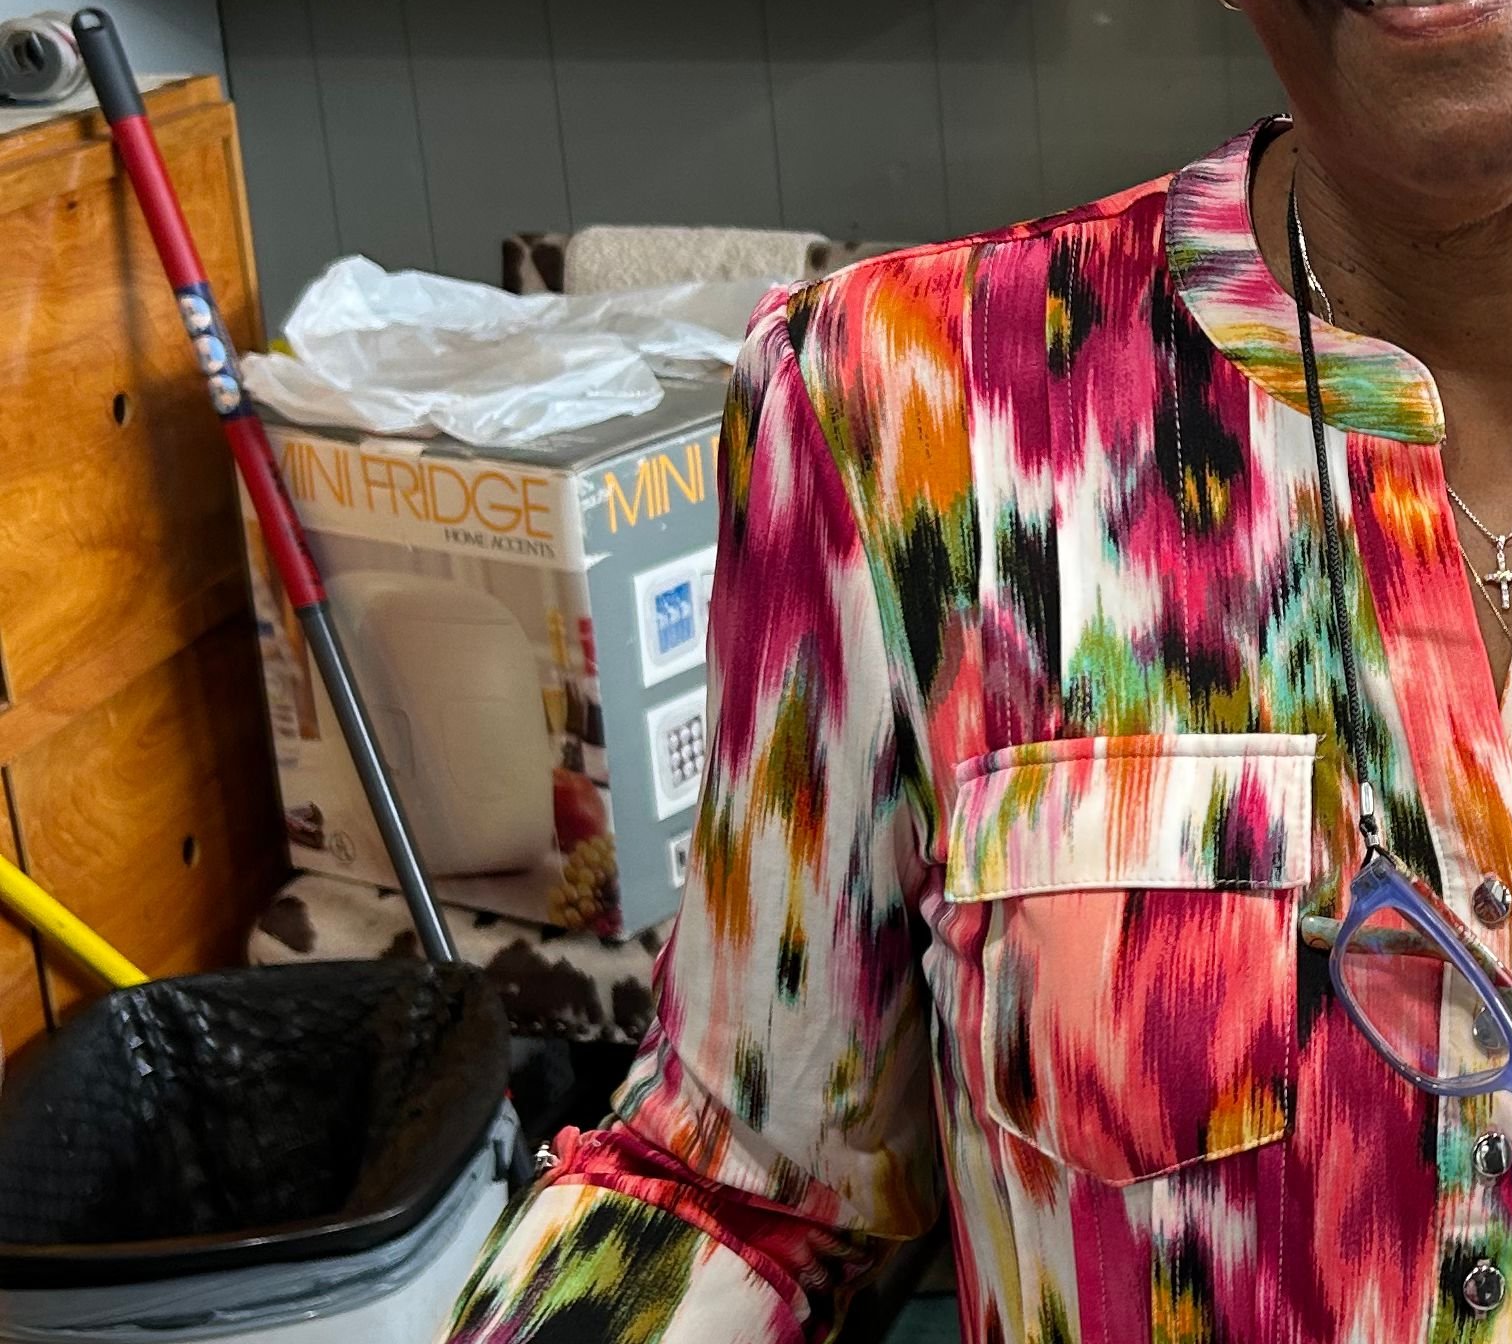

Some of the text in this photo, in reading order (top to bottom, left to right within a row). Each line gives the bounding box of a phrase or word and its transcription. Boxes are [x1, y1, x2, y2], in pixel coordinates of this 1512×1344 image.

[361, 454, 554, 540] FRIDGE
[604, 443, 705, 534] MINI
[444, 527, 555, 558] HOME ACCENTS
